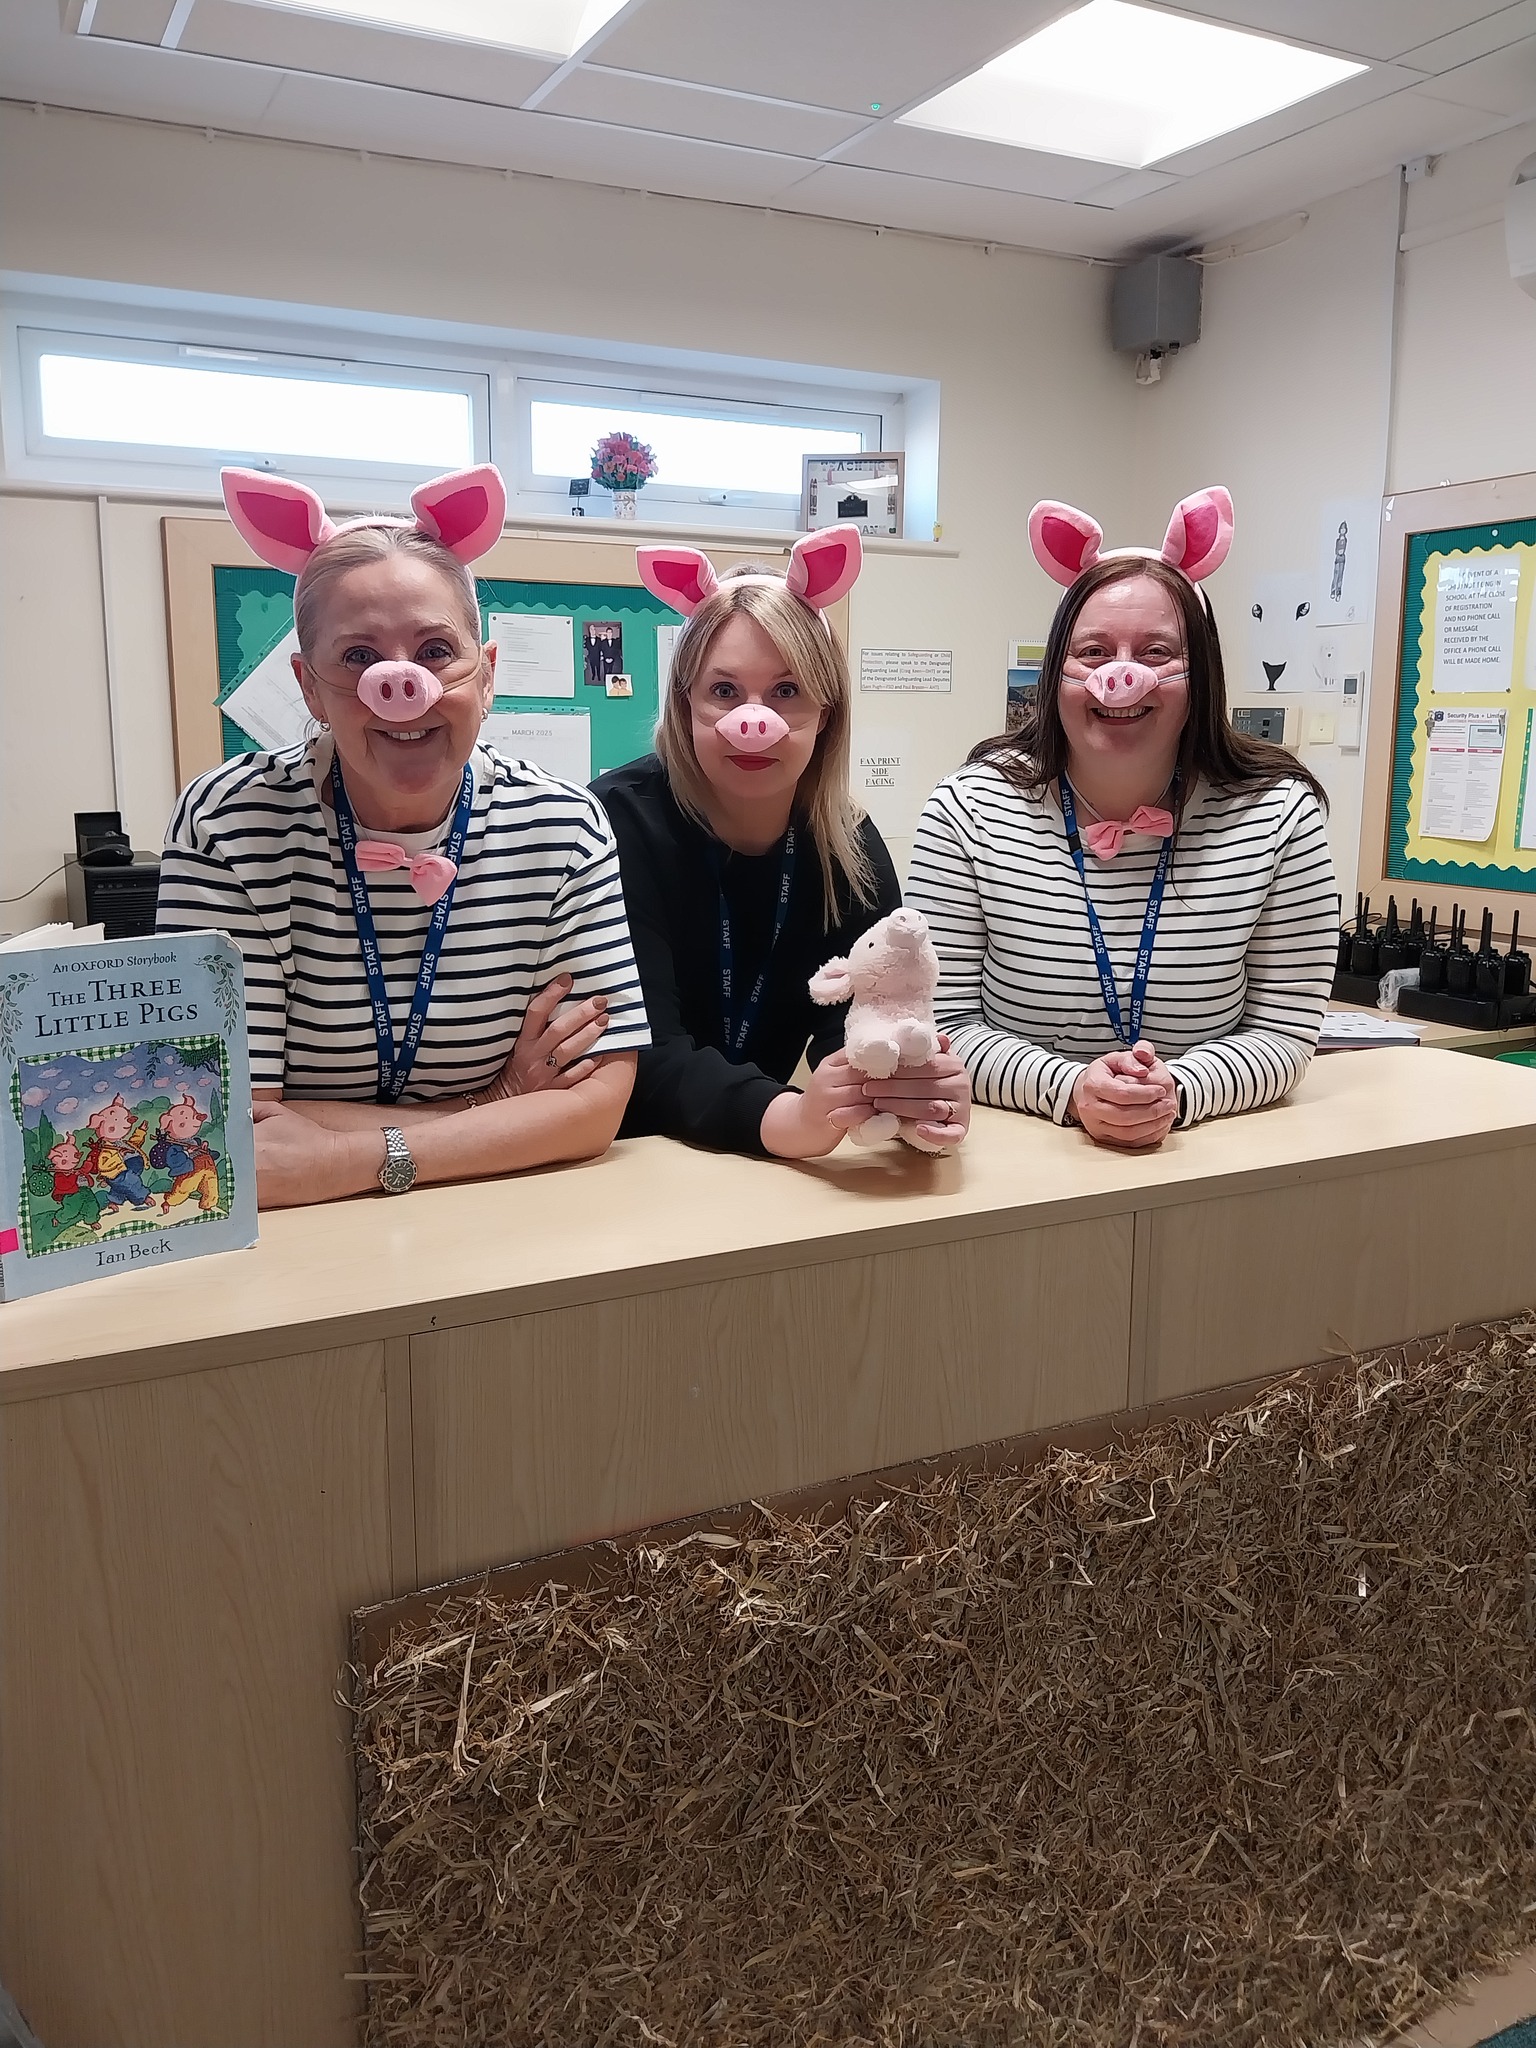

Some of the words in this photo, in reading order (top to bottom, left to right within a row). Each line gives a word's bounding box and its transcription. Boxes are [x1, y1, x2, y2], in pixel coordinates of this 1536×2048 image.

[1453, 603, 1493, 611] REGISTRATION
[877, 757, 901, 765] PRINT
[461, 771, 472, 809] STAFF
[865, 778, 895, 786] FACING
[338, 813, 354, 850] STAFF
[448, 831, 462, 864] STAF
[1155, 851, 1168, 880] STAFF
[350, 876, 368, 913] STAFF
[780, 873, 791, 903] STAFF
[1061, 788, 1073, 816] STAFF
[1091, 925, 1105, 954] STAFF
[1101, 973, 1116, 1004] STAFF
[433, 893, 449, 930] STAFF
[1145, 899, 1159, 930] STAFF
[722, 919, 731, 950] STAFF
[52, 963, 69, 974] An
[71, 957, 124, 973] OXFORD
[127, 951, 177, 968] Storybook
[363, 938, 379, 976] STAFF
[418, 952, 435, 990] STAFF
[1136, 949, 1149, 980] STAFF
[47, 991, 87, 1008] THE
[87, 978, 182, 1003] THREE
[722, 968, 731, 999] STAFF
[750, 973, 765, 1003] STAFF
[34, 1010, 130, 1038] LITTLE
[138, 1002, 199, 1025] PIGS
[374, 999, 389, 1036] STAFF
[405, 1012, 422, 1049] STAFF
[1131, 999, 1141, 1031] STAFF
[723, 1017, 731, 1046] STAFF
[735, 1019, 750, 1050] STAFF
[381, 1060, 391, 1087] STAFF
[390, 1069, 407, 1096] STAFF
[95, 1250, 126, 1267] Ian
